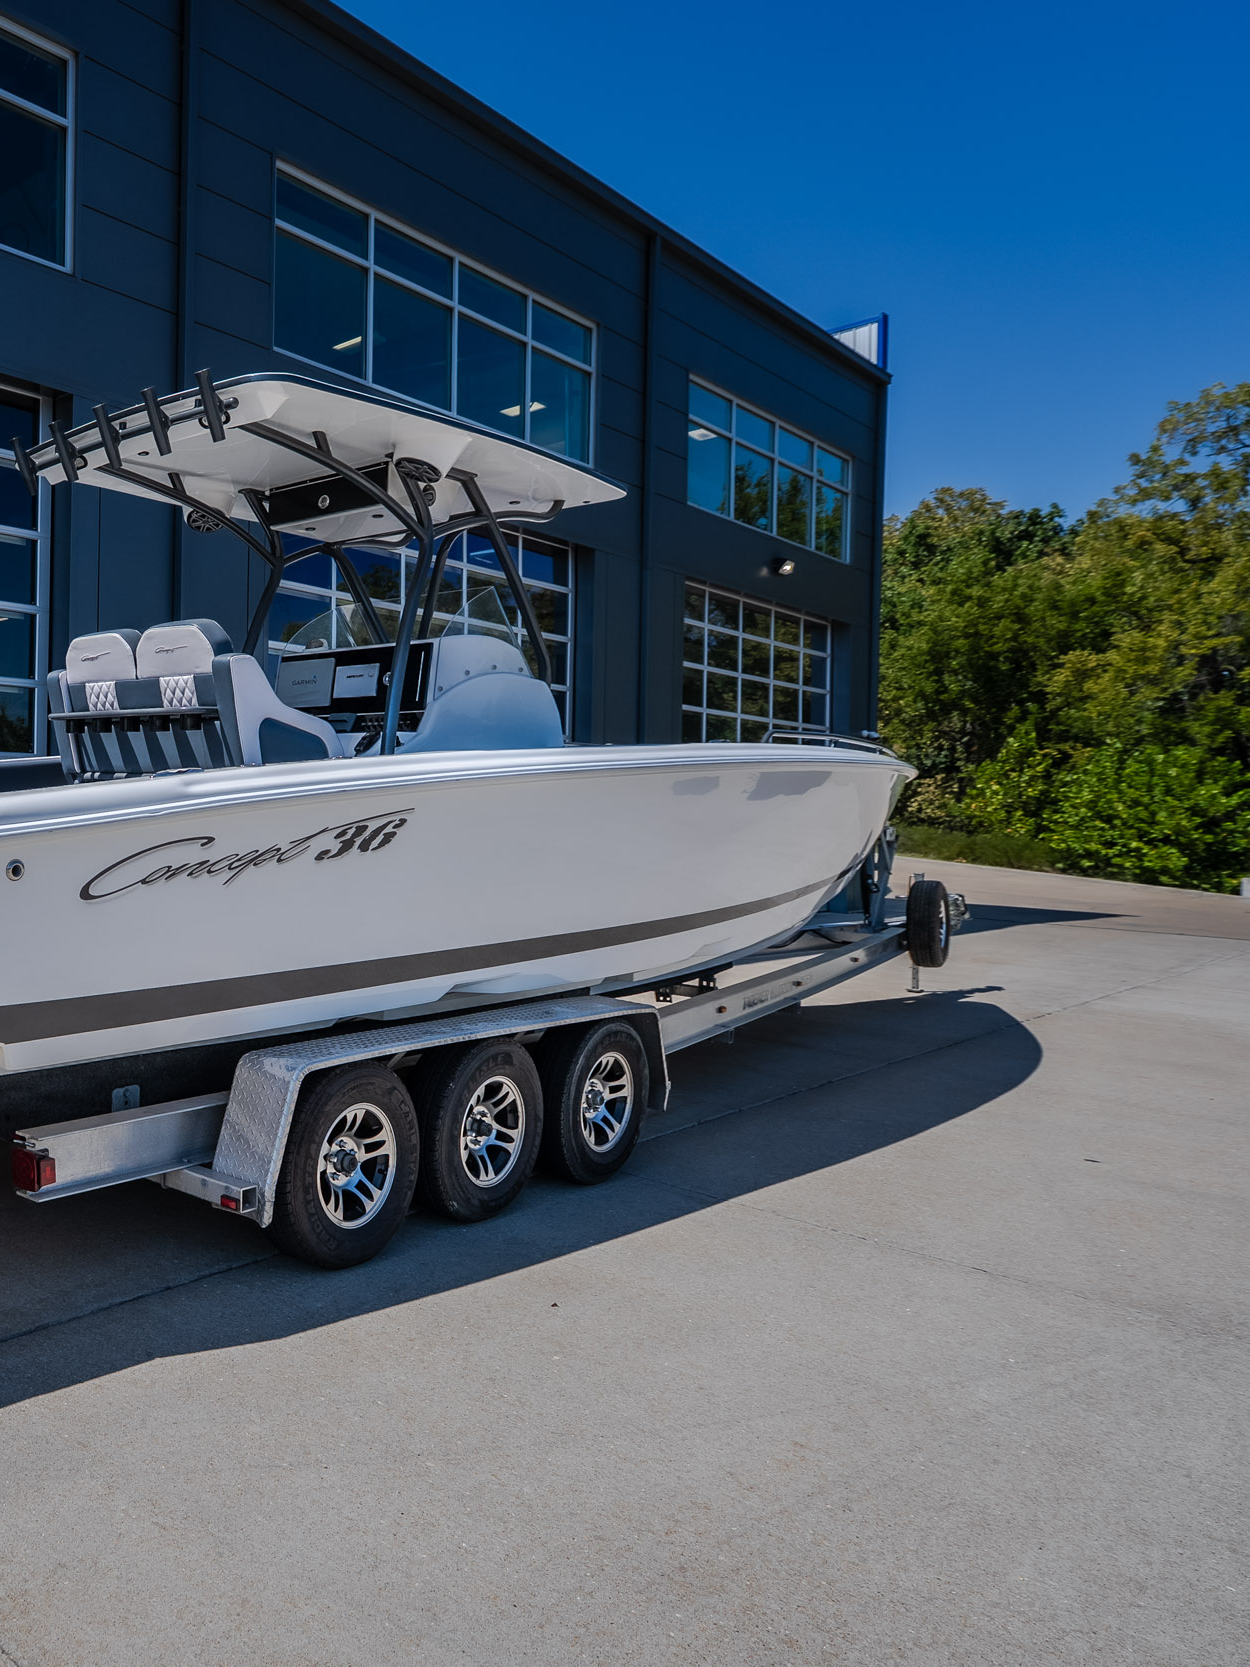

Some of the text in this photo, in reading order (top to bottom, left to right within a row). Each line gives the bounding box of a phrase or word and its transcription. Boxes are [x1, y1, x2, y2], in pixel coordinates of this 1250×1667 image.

[291, 678, 318, 686] GARMIN
[79, 808, 415, 901] Concept 36
